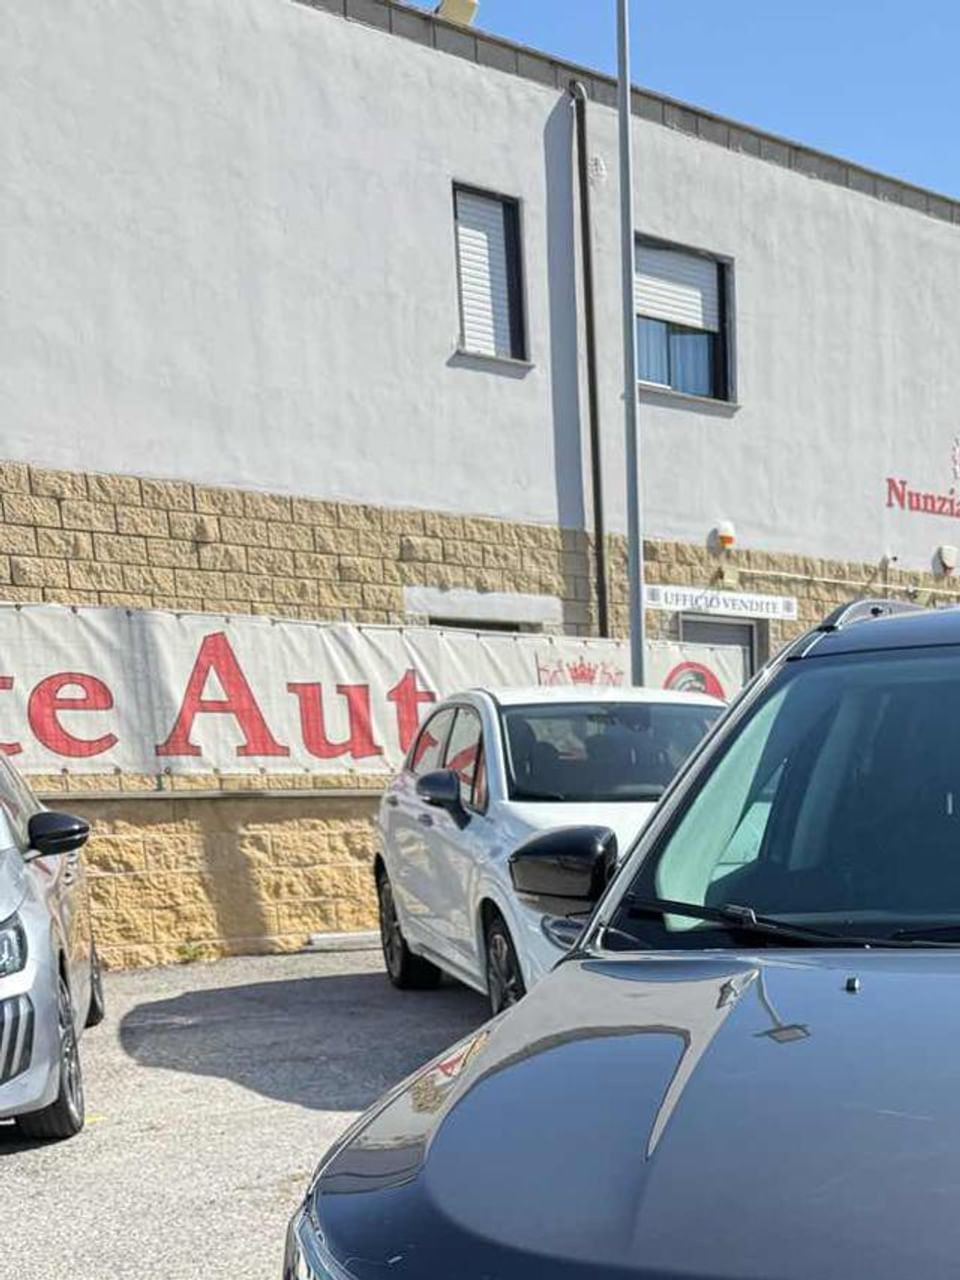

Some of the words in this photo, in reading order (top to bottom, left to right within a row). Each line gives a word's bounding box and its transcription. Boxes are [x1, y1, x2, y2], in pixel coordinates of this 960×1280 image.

[664, 591, 720, 609] UFFICIO
[721, 597, 778, 614] VENDITE
[154, 631, 480, 765] Aut
